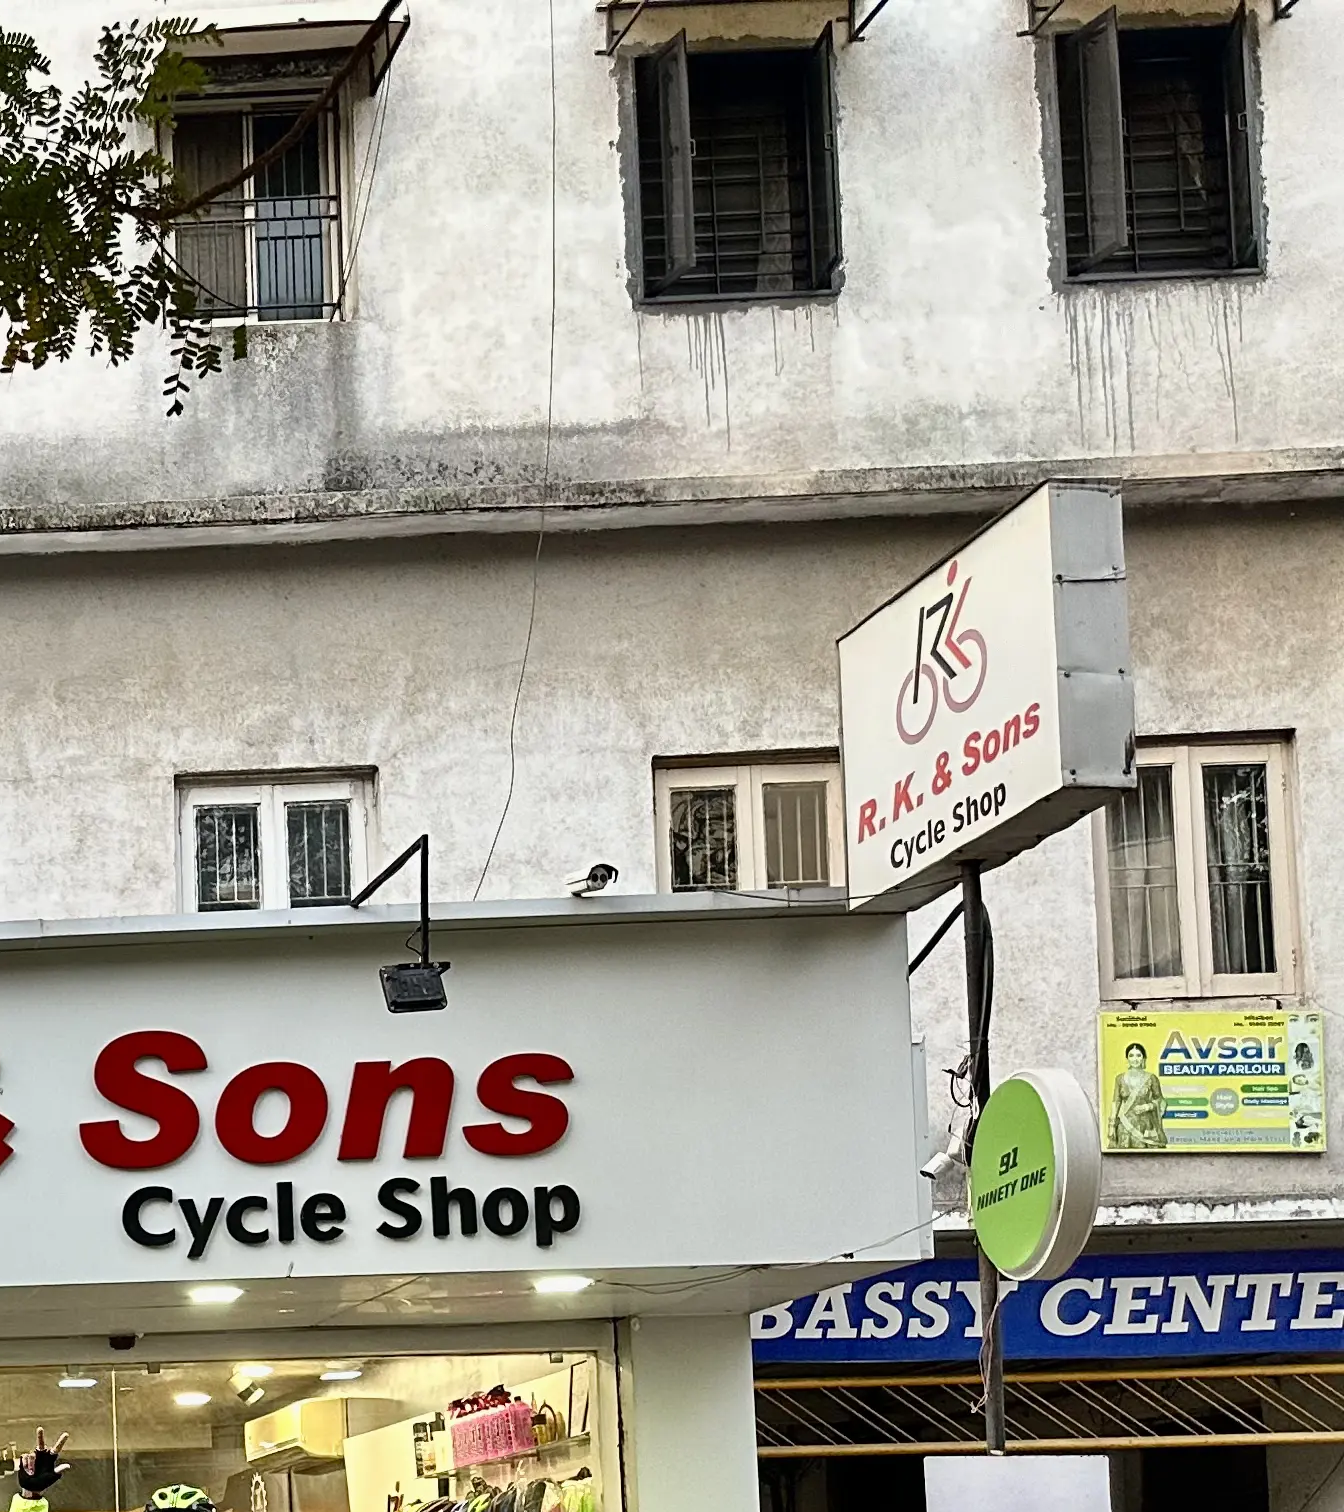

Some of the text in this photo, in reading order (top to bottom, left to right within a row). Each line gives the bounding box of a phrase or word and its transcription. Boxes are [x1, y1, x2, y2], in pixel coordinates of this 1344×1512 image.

[857, 702, 1041, 845] R. K. & Sons
[890, 782, 1007, 869] Cycle Shop
[1159, 1030, 1283, 1060] Avsar
[1163, 1065, 1281, 1076] BEAUTY PARLOUR
[78, 1030, 576, 1170] Sons
[976, 1166, 1047, 1212] NINETY ONE
[998, 1146, 1019, 1176] 91
[121, 1175, 582, 1260] Cycle Shop
